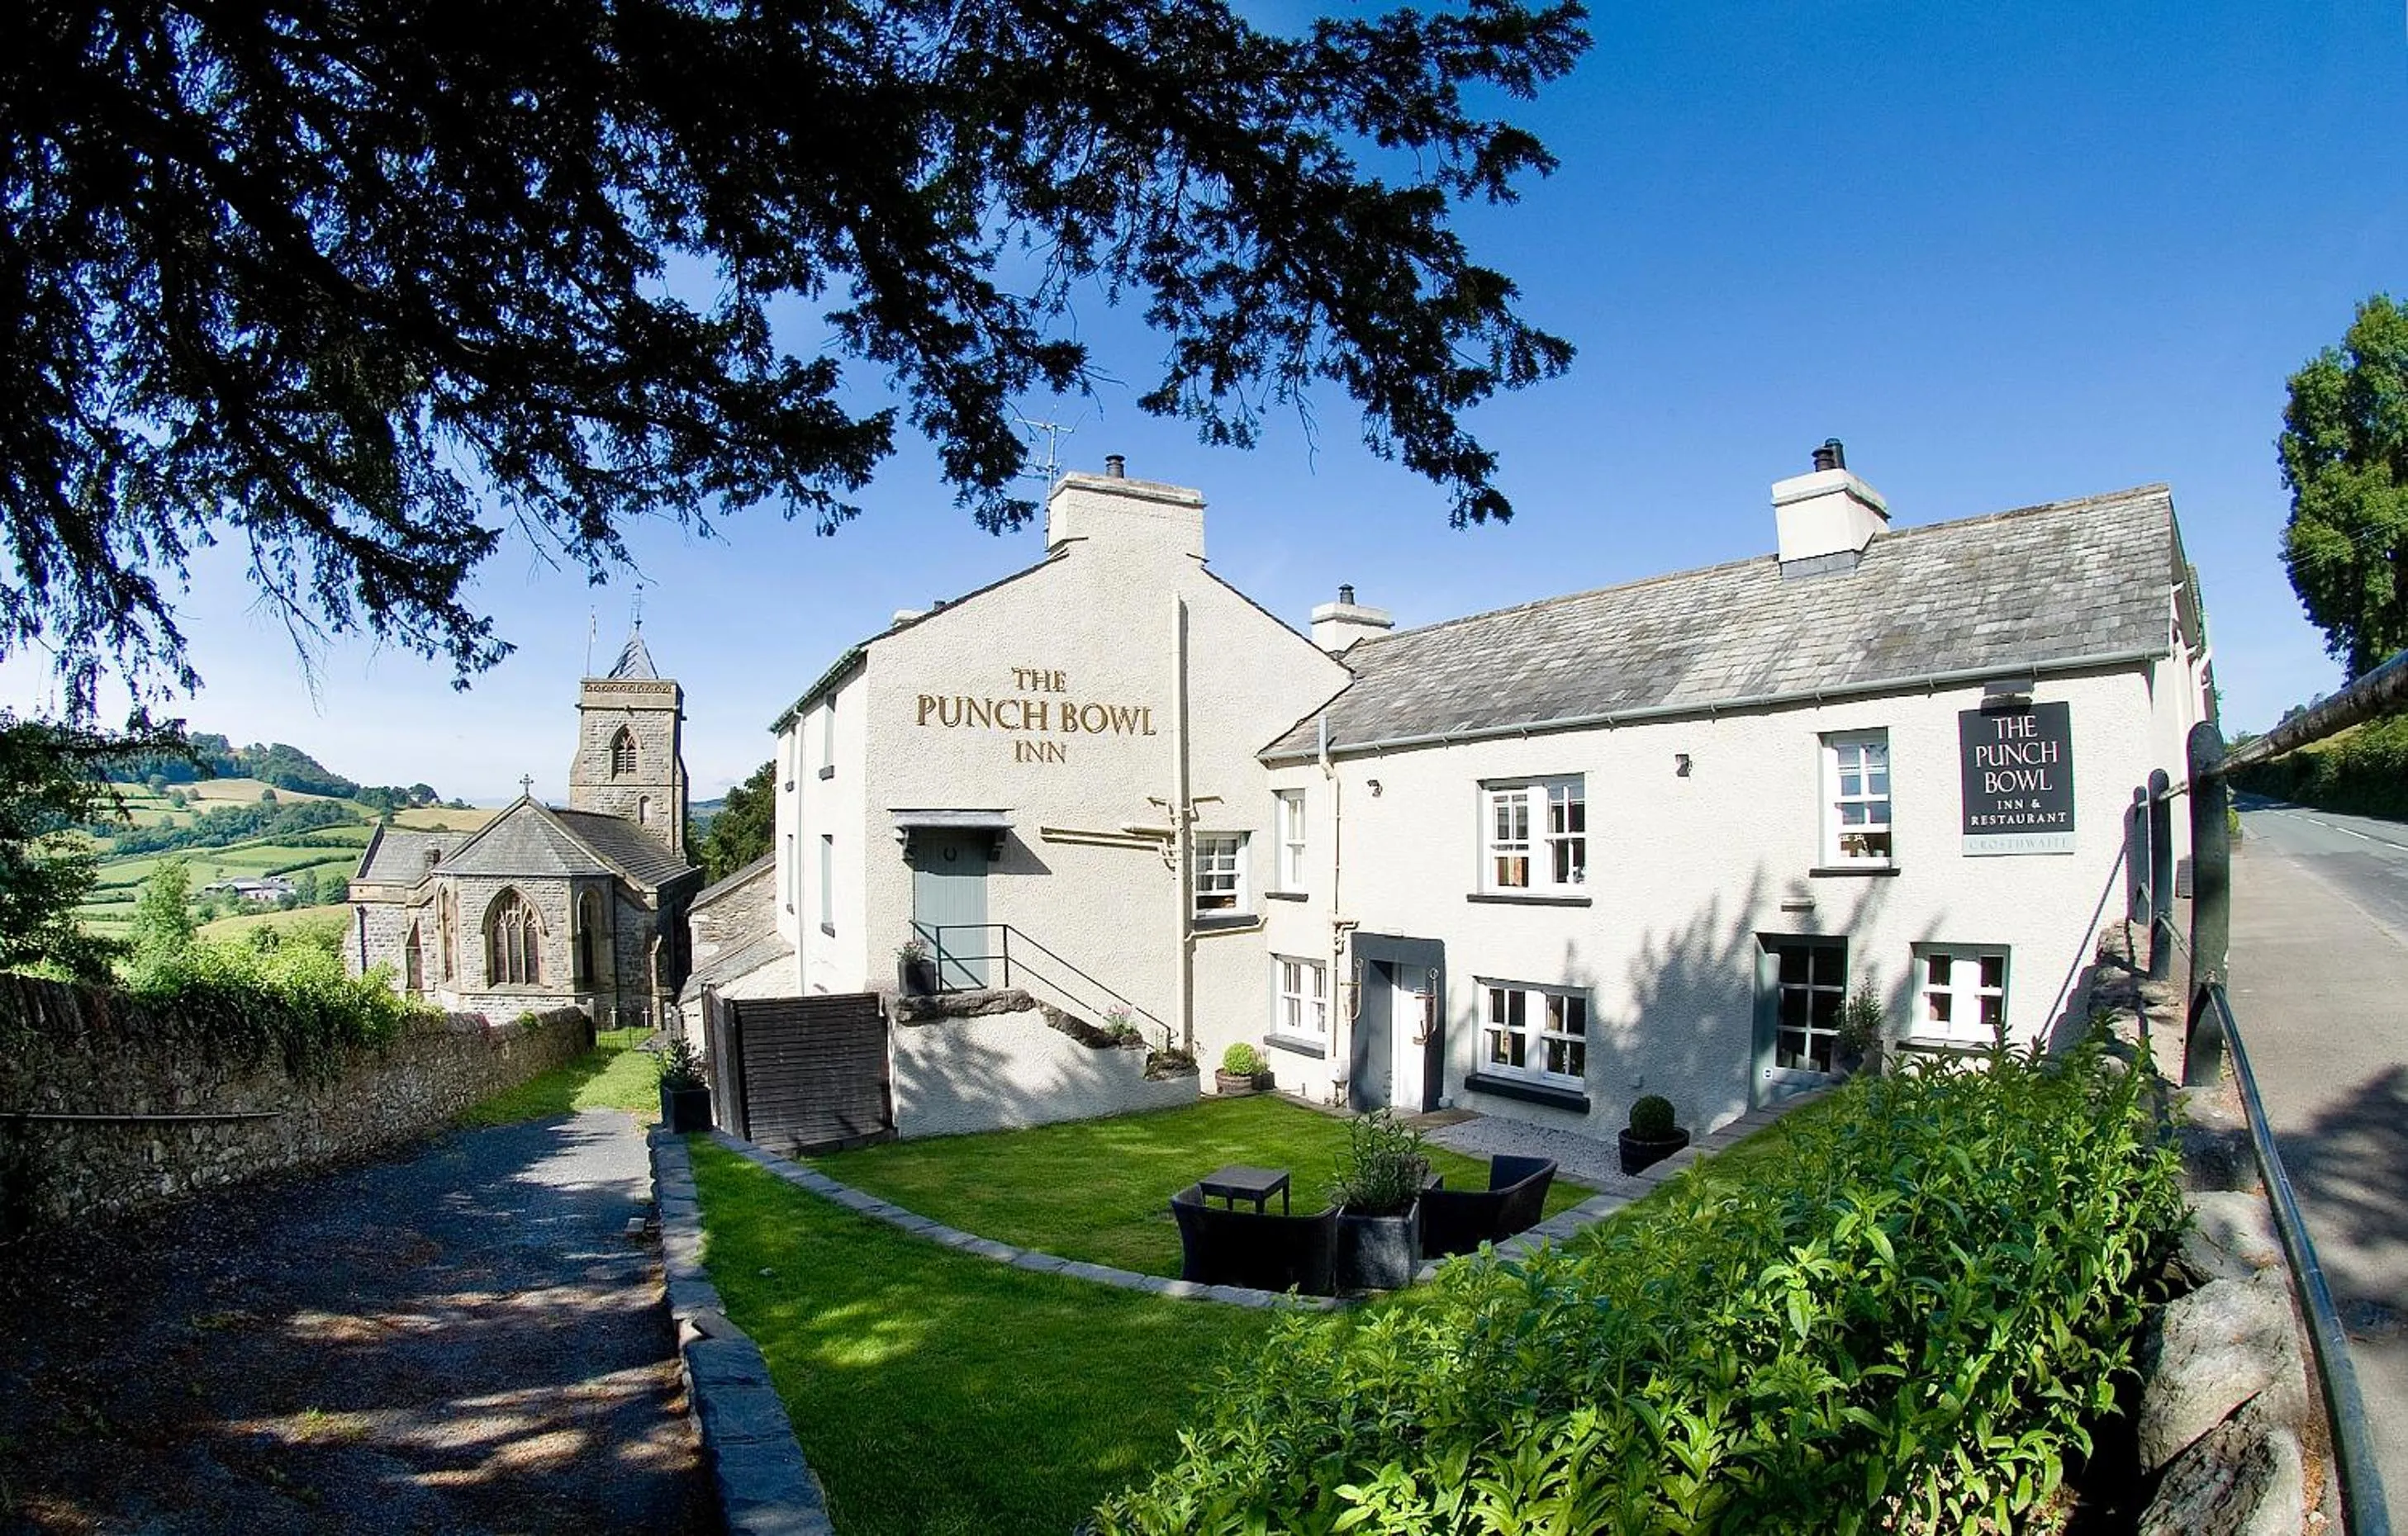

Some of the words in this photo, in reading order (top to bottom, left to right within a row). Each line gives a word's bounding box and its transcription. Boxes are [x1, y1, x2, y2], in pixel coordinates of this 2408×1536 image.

[1011, 666, 1066, 693] THE
[916, 695, 1049, 732] PUNCH
[1059, 700, 1157, 736] BOWL
[1992, 716, 2038, 739] THE
[1015, 740, 1067, 764] INN
[1975, 741, 2059, 768] PUNCH
[1984, 769, 2053, 794] BOWL
[1997, 799, 2024, 810] INN
[2031, 799, 2041, 808] &
[1971, 812, 2067, 826] RESTAURANT
